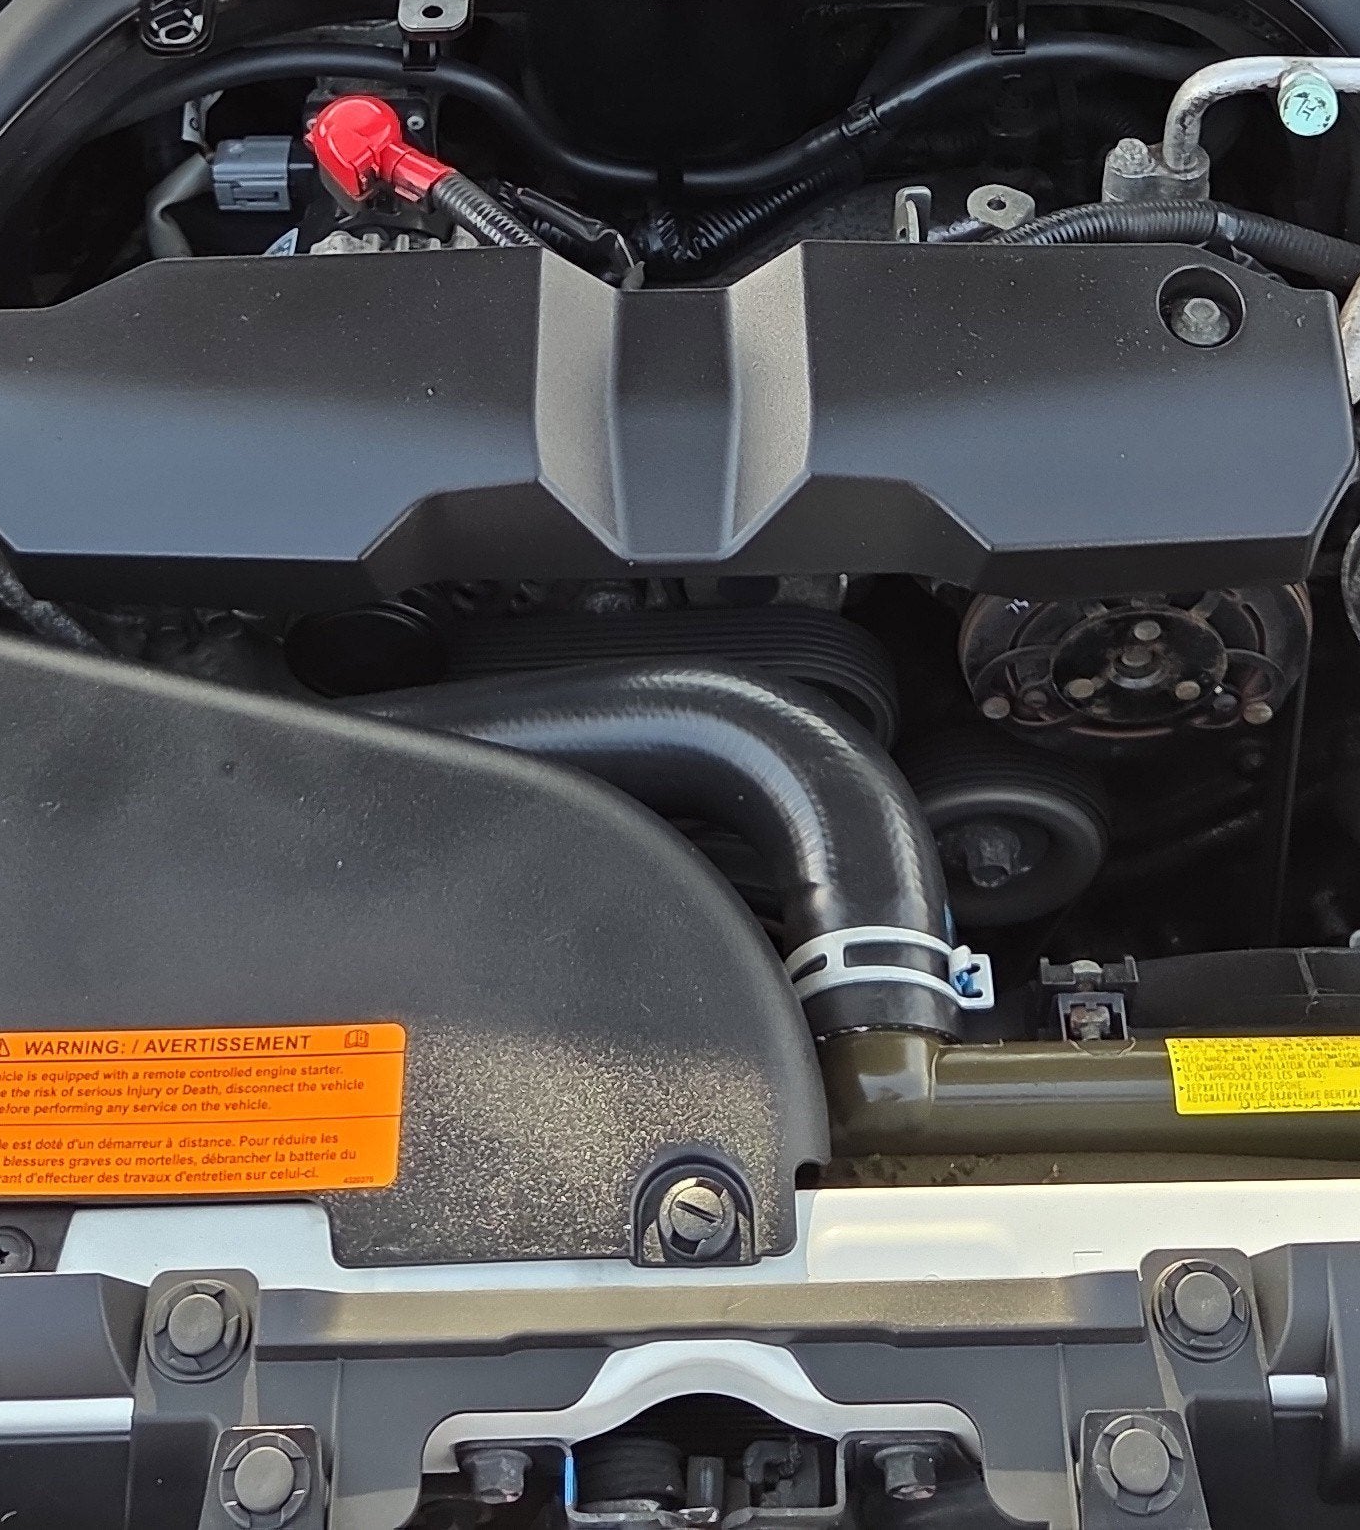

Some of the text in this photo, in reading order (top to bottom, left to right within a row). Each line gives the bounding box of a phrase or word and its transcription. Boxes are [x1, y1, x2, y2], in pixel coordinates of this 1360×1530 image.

[25, 1039, 126, 1055] WARNING:
[144, 1035, 312, 1054] AVERTISSEMENT
[27, 1070, 38, 1081] is
[41, 1070, 99, 1083] equipped
[103, 1069, 128, 1080] with
[132, 1071, 139, 1080] a
[143, 1068, 186, 1079] remote
[190, 1066, 251, 1078] controlled
[256, 1066, 297, 1078] engine
[300, 1065, 343, 1076] starter.
[1257, 1071, 1273, 1080] PAS
[11, 1087, 30, 1098] the
[33, 1087, 56, 1097] risk
[61, 1086, 74, 1097] of
[78, 1086, 123, 1097] serious
[165, 1086, 179, 1095] or
[183, 1083, 221, 1095] Death,
[225, 1081, 294, 1094] disconnect
[297, 1080, 316, 1092] the
[321, 1079, 364, 1091] vehicle
[33, 1102, 102, 1116] performing
[106, 1104, 129, 1115] any
[133, 1101, 177, 1113] service
[181, 1102, 197, 1111] on
[201, 1100, 220, 1111] the
[224, 1099, 271, 1110] vehicle.
[12, 1139, 31, 1150] est
[35, 1138, 63, 1150] doté
[67, 1138, 94, 1149] d'un
[98, 1137, 162, 1149] démarreur
[165, 1137, 173, 1148] à
[179, 1136, 235, 1148] distance.
[240, 1135, 269, 1146] Pour
[273, 1134, 317, 1145] réduire
[321, 1132, 338, 1143] les
[3, 1156, 65, 1167] blessures
[69, 1157, 111, 1169] graves
[115, 1157, 132, 1166] ou
[135, 1154, 198, 1166] mortelles,
[201, 1152, 271, 1165] débrancher
[275, 1151, 285, 1162] la
[289, 1150, 336, 1162] batterie
[340, 1149, 356, 1160] du
[25, 1171, 93, 1184] d'effectuer
[97, 1171, 119, 1183] des
[123, 1171, 171, 1183] travaux
[174, 1170, 241, 1182] d'entretien
[245, 1171, 265, 1181] sur
[269, 1168, 319, 1180] celui-ci.
